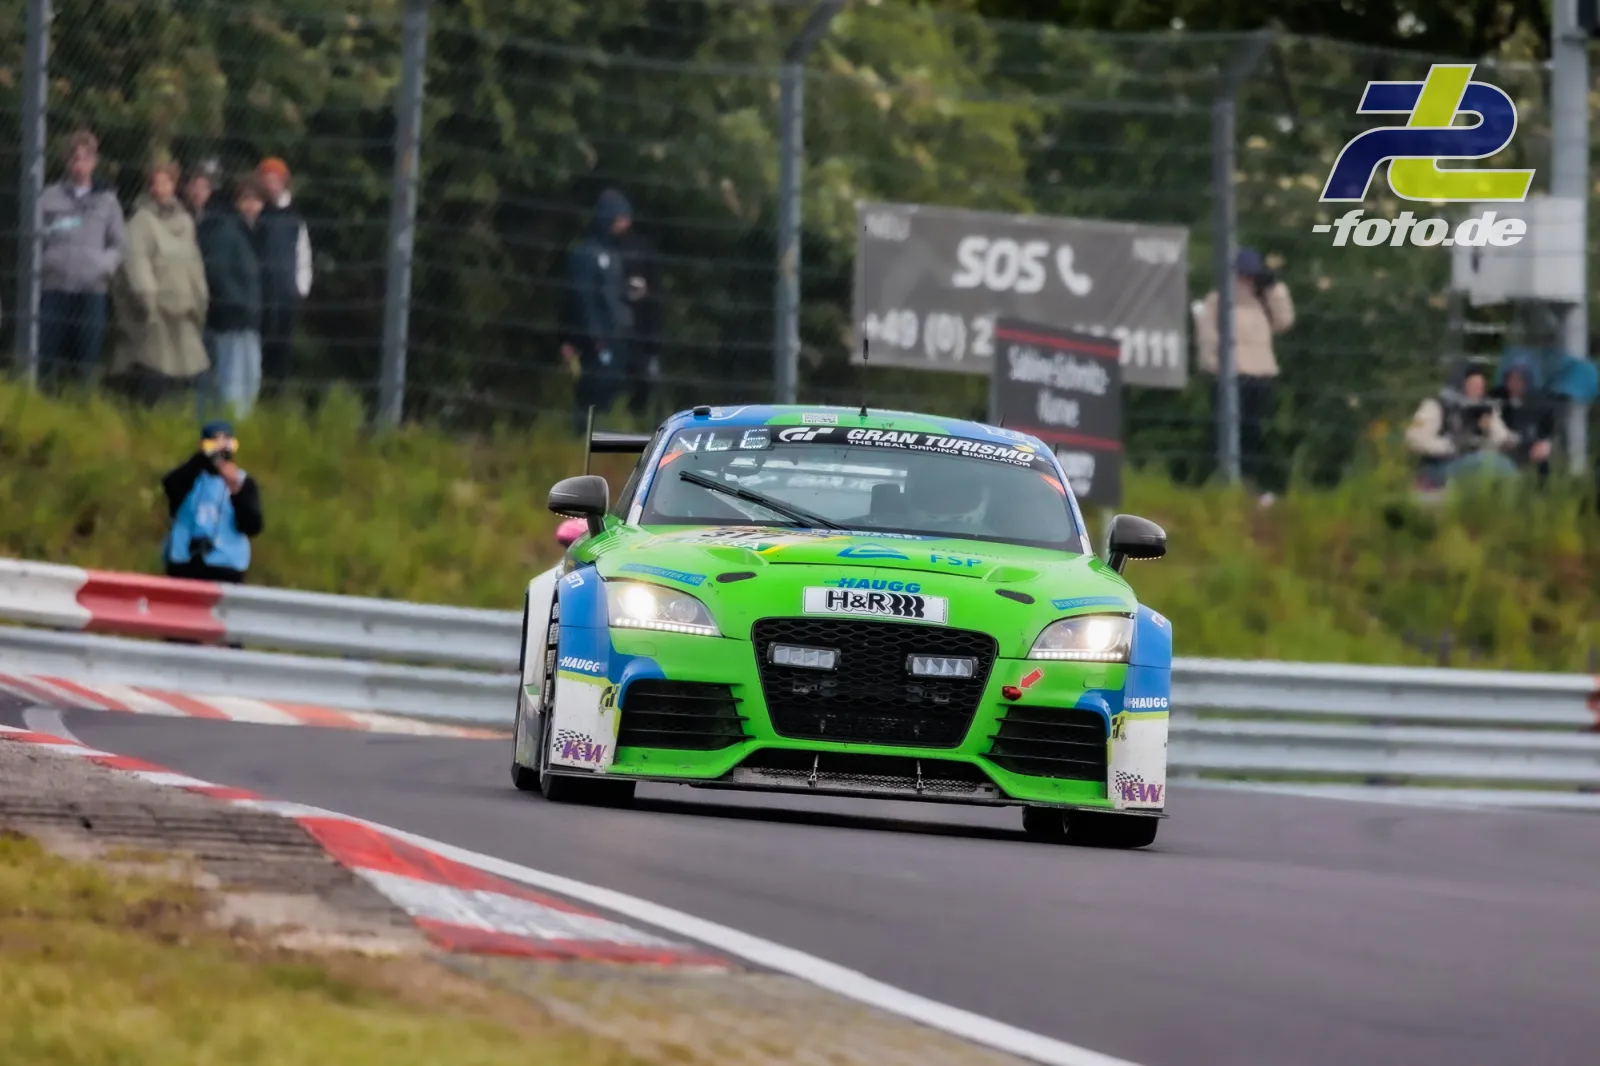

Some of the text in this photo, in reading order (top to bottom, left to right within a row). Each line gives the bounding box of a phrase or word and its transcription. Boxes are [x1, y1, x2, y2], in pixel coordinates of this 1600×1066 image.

[952, 235, 1050, 293] SOS
[923, 312, 967, 361] (0)
[847, 429, 1035, 462] GRAN TURISMO
[875, 441, 905, 449] REAL
[909, 443, 959, 455] DRIVING
[962, 451, 1031, 468] SIMULATOR
[930, 554, 982, 567] FSP
[838, 578, 921, 593] HAUGG
[827, 590, 886, 612] H&R
[1130, 697, 1168, 709] HAUGG
[561, 740, 607, 763] KW
[1121, 782, 1163, 802] KW
